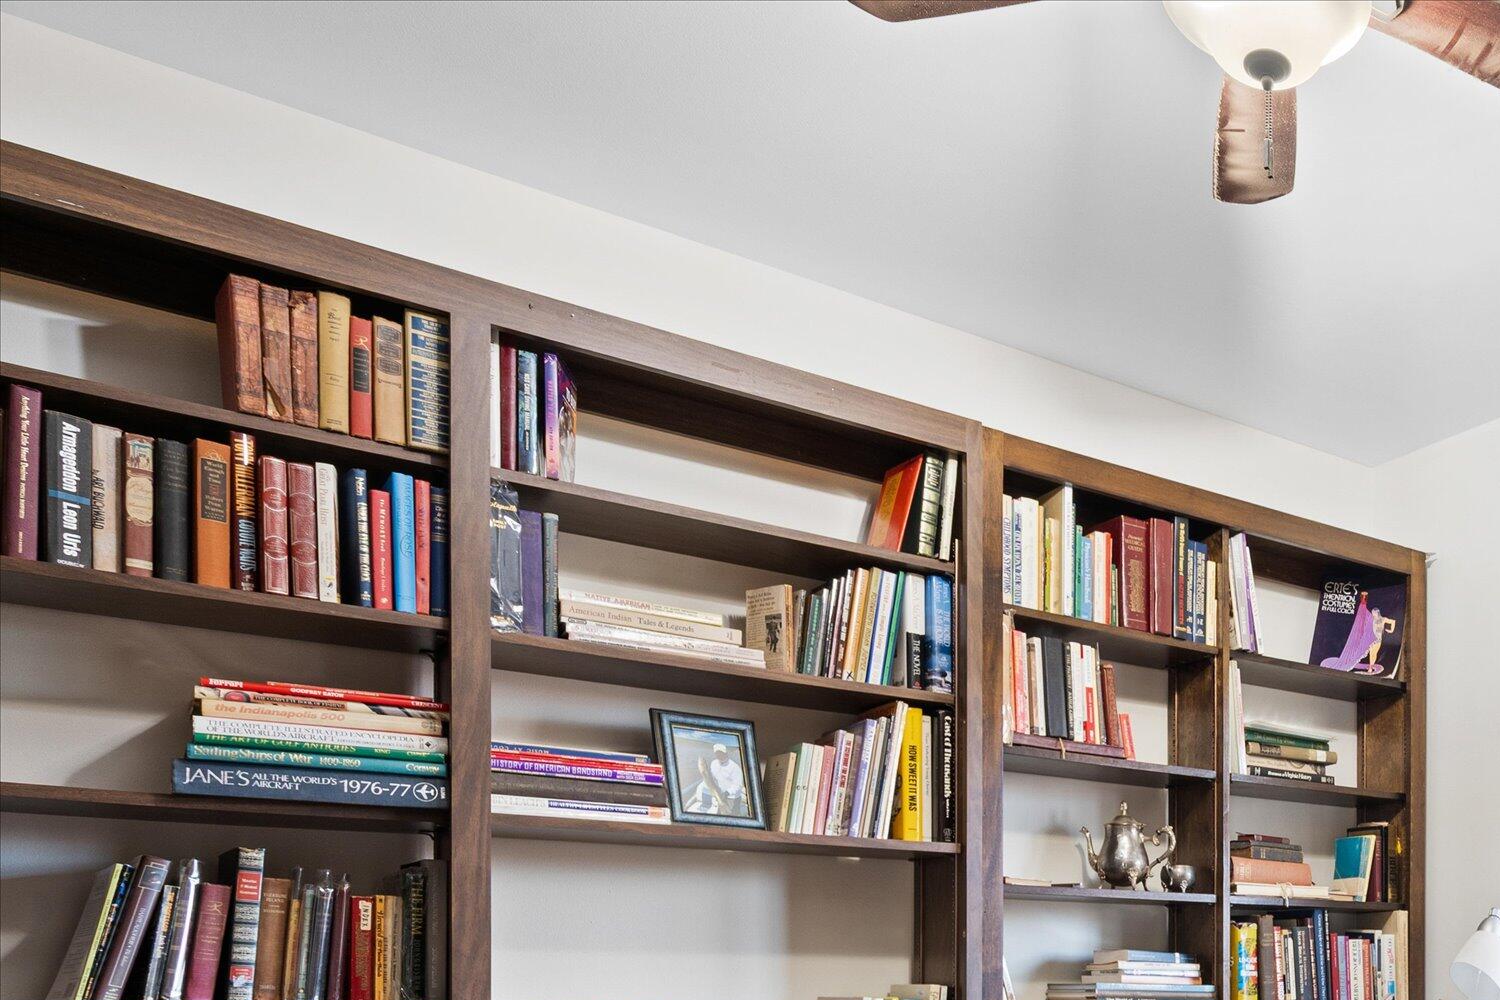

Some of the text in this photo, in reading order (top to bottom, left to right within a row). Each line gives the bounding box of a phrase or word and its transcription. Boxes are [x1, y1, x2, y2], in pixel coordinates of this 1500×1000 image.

[58, 421, 80, 493] Armageddon
[234, 438, 256, 518] TONY HILLERMAN
[92, 491, 106, 530] BUCHWALD
[62, 501, 81, 558] Leon Uris
[238, 518, 256, 572] COYOTE WAITS
[1003, 518, 1013, 594] CHILDHOOD SYMPTOMS
[568, 606, 606, 618] American
[608, 612, 632, 622] Indian
[636, 616, 657, 626] Tales
[666, 622, 694, 634] Legends
[912, 640, 921, 676] THE NOVEL
[215, 704, 345, 722] the Indianapolis 500
[230, 721, 279, 732] COMPLETE
[284, 726, 348, 737] ILLUSTRATED
[348, 731, 414, 743] ENCYCLOPEDIA
[288, 732, 335, 743] AIRCRAFT
[944, 716, 952, 736] Cast
[194, 744, 238, 760] Sailing
[239, 748, 273, 761] Ships
[272, 752, 286, 762] of
[288, 754, 314, 765] War
[272, 739, 300, 748] GOLF
[302, 742, 356, 752] ANTIQUES
[908, 744, 918, 762] HOW
[491, 759, 522, 770] HISTORY
[524, 762, 534, 770] OF
[534, 763, 572, 774] AMERICAN
[572, 766, 613, 778] BANDSTAND
[908, 763, 918, 786] SWEET
[944, 748, 952, 798] Thousands
[182, 766, 412, 798] JANE'S ALL THE WORLD'S 1976-77
[251, 780, 300, 791] AIRCRAFT
[908, 795, 918, 812] WAS
[362, 904, 370, 928] INDEX
[412, 880, 424, 936] THE FIRM
